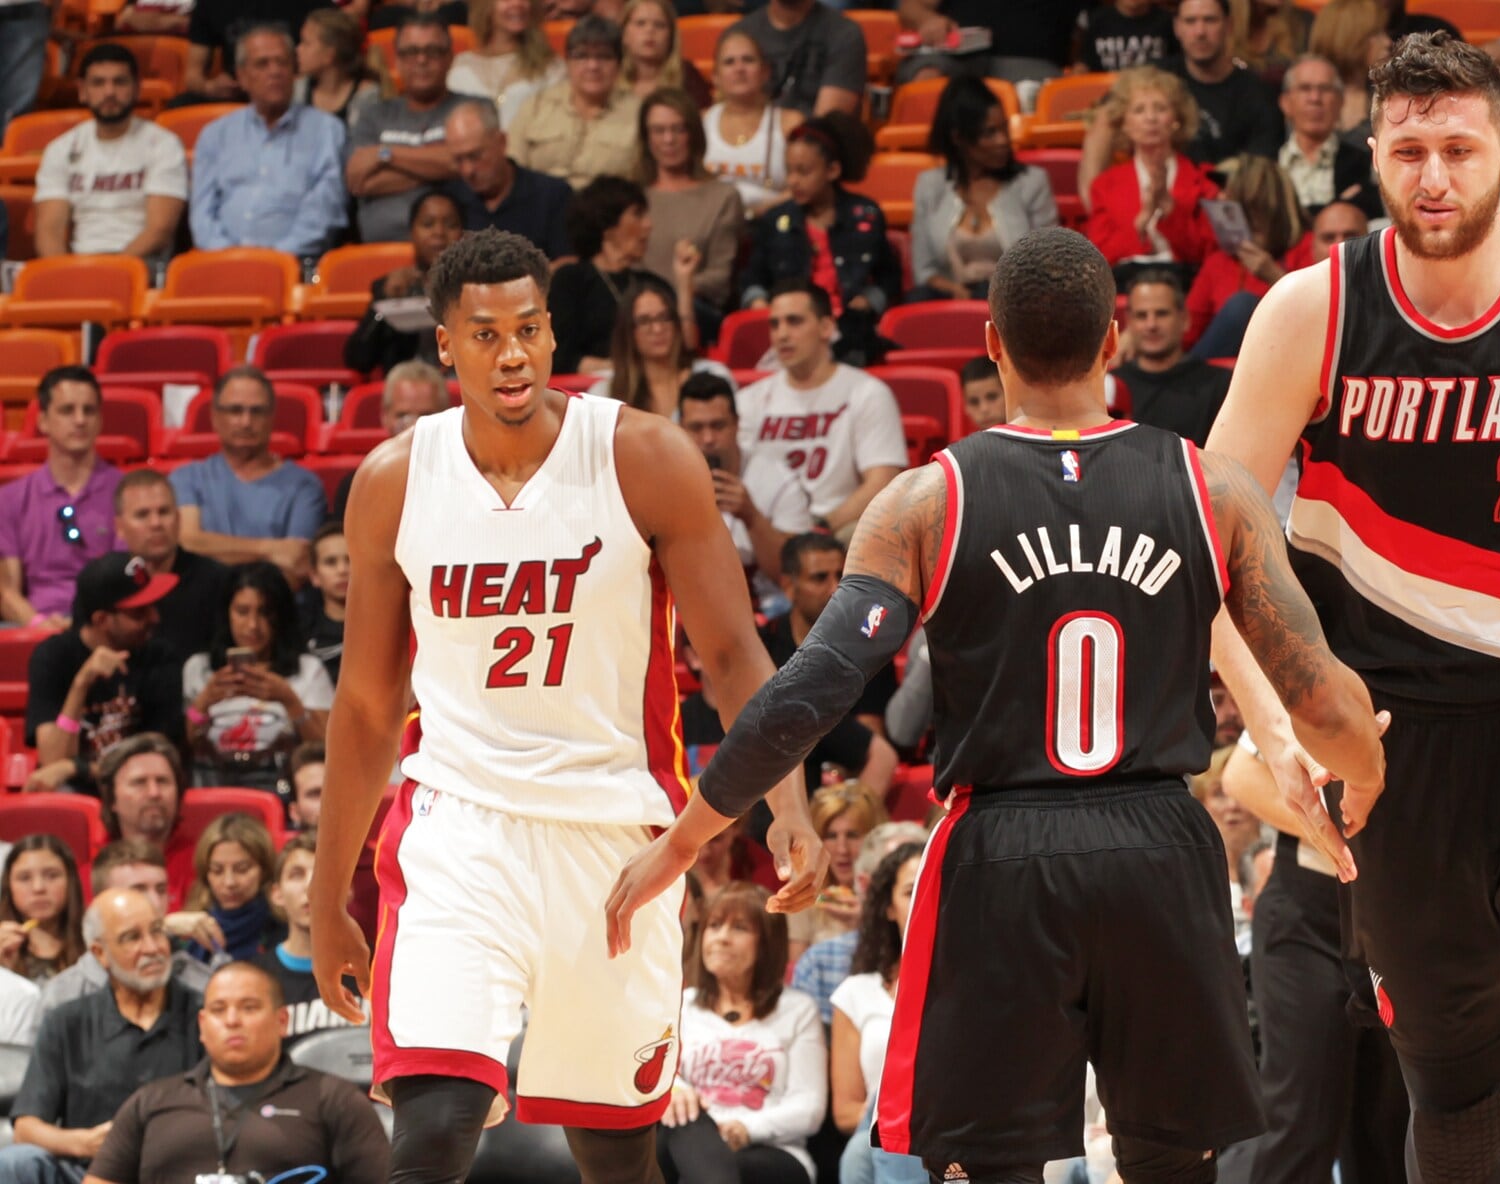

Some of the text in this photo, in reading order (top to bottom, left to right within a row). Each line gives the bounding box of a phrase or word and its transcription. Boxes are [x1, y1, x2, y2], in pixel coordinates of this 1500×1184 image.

[758, 403, 848, 441] HEAT
[430, 535, 603, 618] HEAT
[990, 523, 1182, 596] LILLARD
[485, 622, 574, 689] 21
[1045, 610, 1125, 777] 0
